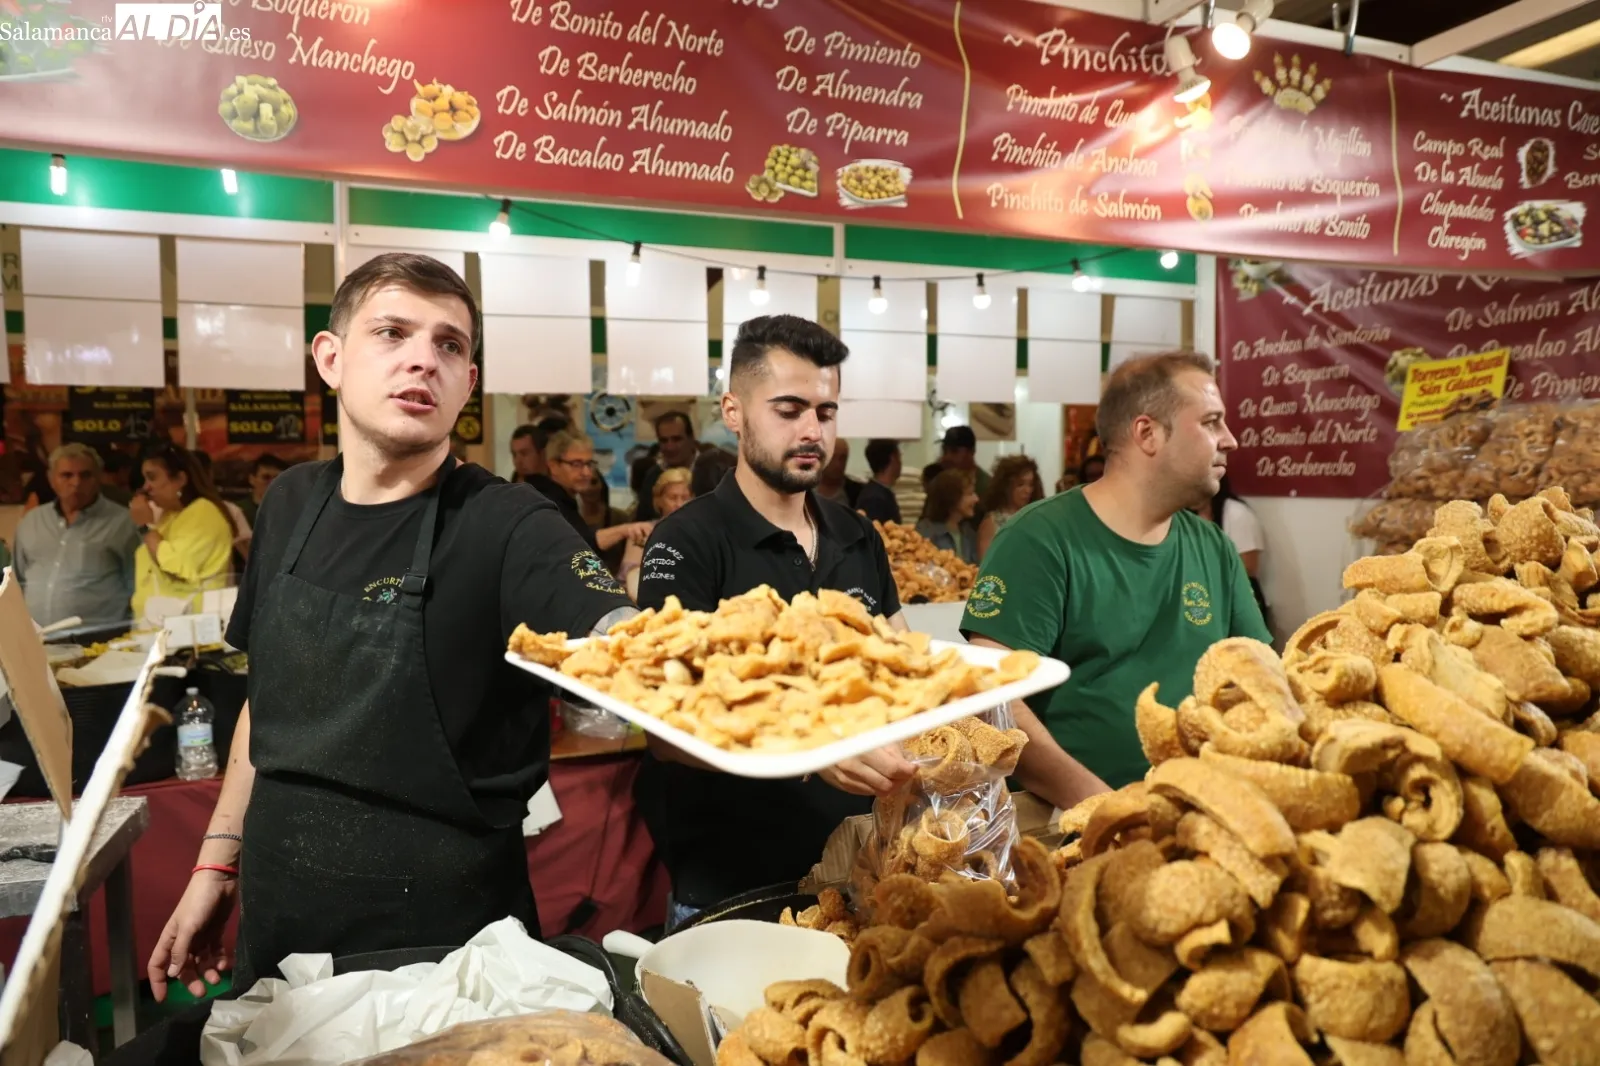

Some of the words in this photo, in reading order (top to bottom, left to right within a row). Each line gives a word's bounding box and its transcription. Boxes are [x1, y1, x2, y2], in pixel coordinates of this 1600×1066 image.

[510, 0, 542, 25] De
[550, 1, 623, 39] Bonito
[627, 11, 664, 45] del
[665, 20, 724, 56] Norte
[784, 26, 816, 55] De
[824, 31, 921, 68] Pimiento
[287, 32, 415, 95] Manchego
[538, 46, 570, 77] De
[577, 52, 697, 95] Berberecho
[1035, 28, 1173, 77] Pinchito
[776, 65, 807, 93] De
[812, 69, 923, 109] Almendra
[1006, 83, 1078, 123] Pinchito
[1078, 90, 1100, 124] de
[496, 85, 528, 116] De
[535, 89, 622, 128] Salmón
[628, 100, 732, 142] Ahumado
[1460, 87, 1562, 128] Aceitunas
[786, 107, 818, 135] De
[826, 112, 909, 154] Piparra
[1413, 130, 1465, 162] Campo
[1468, 136, 1507, 161] Real
[493, 131, 526, 160] De
[533, 135, 624, 171] Bacalao
[630, 143, 734, 183] Ahumado
[991, 132, 1061, 169] Pinchito
[1064, 138, 1084, 170] de
[1091, 144, 1158, 178] Anchoa
[1414, 161, 1439, 184] De
[1441, 159, 1455, 184] la
[1457, 163, 1505, 190] Abuela
[987, 181, 1065, 214] Pinchito
[1069, 185, 1089, 215] de
[1093, 189, 1161, 220] Salmón
[1311, 170, 1380, 206] Boquerón
[1420, 189, 1496, 226] Chupadedos
[1324, 211, 1371, 239] Bonito
[1428, 223, 1487, 261] Obregón
[1302, 271, 1440, 316] Aceitunas
[1445, 307, 1473, 332] De
[1478, 293, 1561, 328] Salmón
[1232, 341, 1249, 361] De
[1252, 329, 1303, 359] Anchoa
[1304, 325, 1320, 350] de
[1323, 323, 1392, 349] Santoña
[1262, 366, 1280, 387] De
[1239, 398, 1257, 419] De
[1259, 396, 1298, 417] Queso
[1302, 384, 1381, 422] Manchego
[72, 418, 121, 433] SOLO
[229, 421, 274, 433] SOLO
[1241, 427, 1260, 448] De
[1261, 425, 1307, 447] Bonito
[1308, 419, 1330, 445] del
[1332, 421, 1378, 445] Norte
[1256, 456, 1275, 477] De
[1277, 451, 1356, 477] Berberecho
